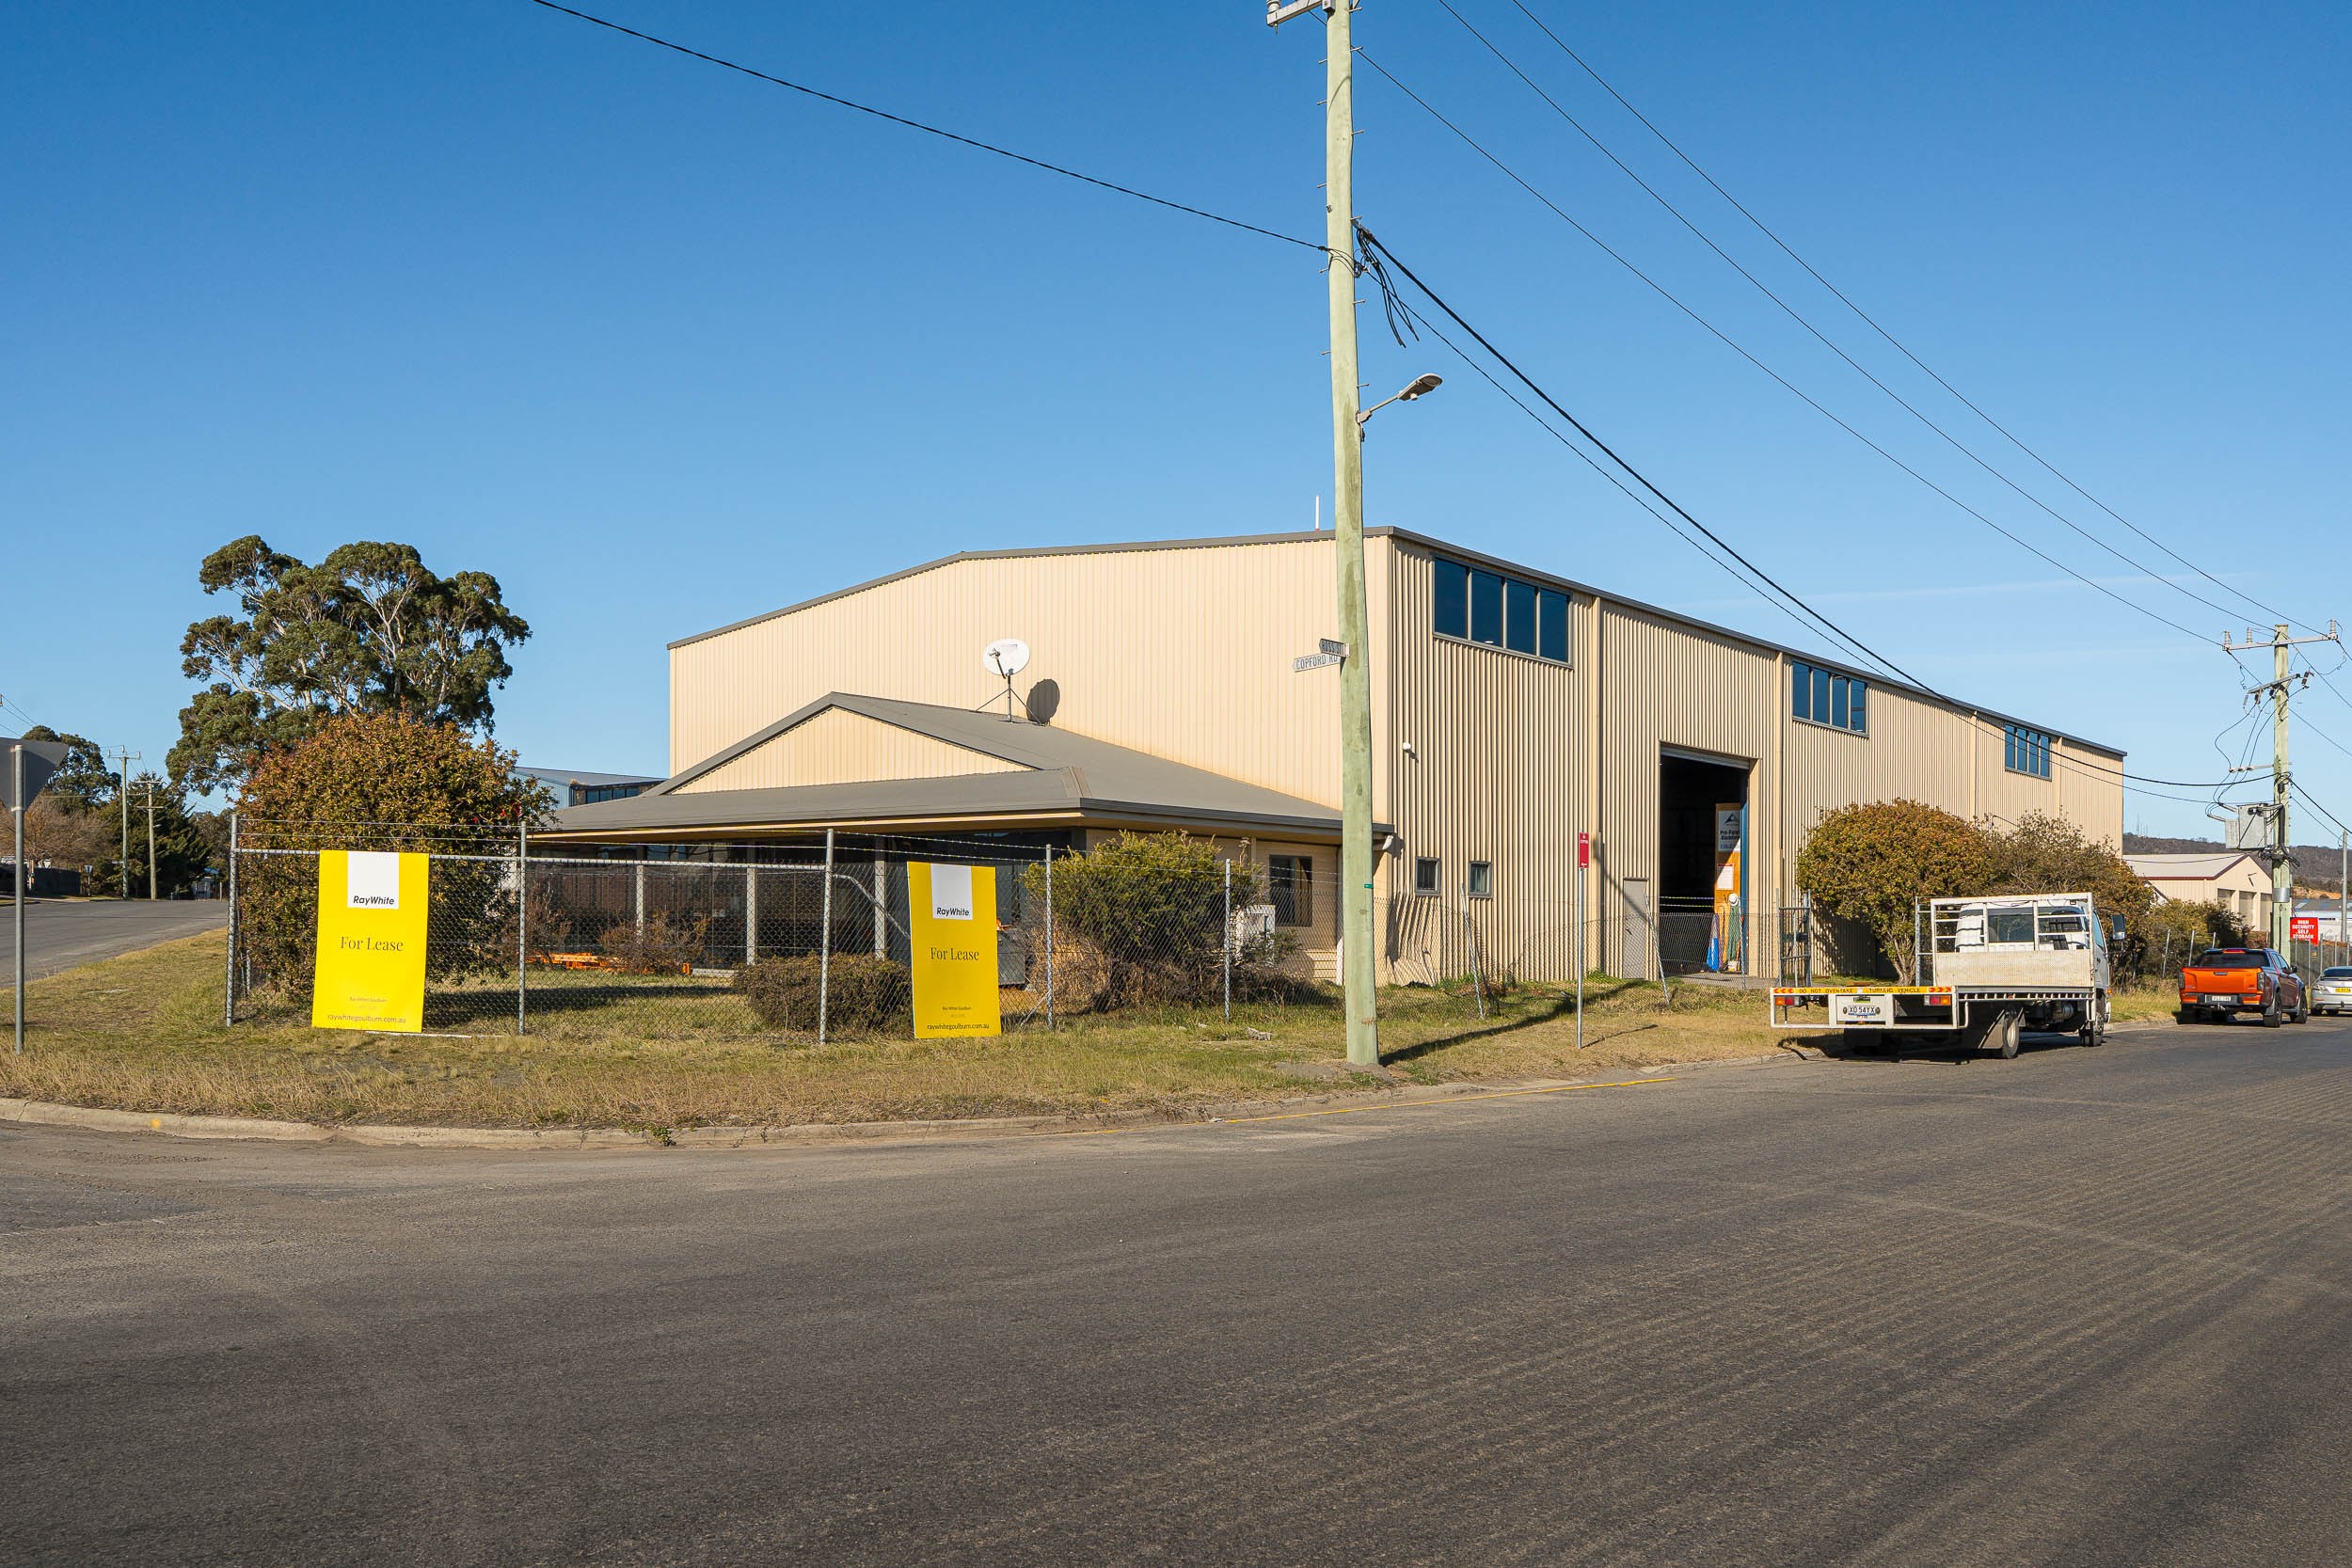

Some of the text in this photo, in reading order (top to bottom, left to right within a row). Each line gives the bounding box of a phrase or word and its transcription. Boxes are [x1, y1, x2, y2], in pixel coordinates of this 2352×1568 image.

[1295, 655, 1327, 670] COPFORD
[353, 895, 395, 905] RayWhite
[936, 907, 970, 916] RayWhite
[340, 936, 404, 952] For Lease
[930, 947, 979, 961] For Lease
[927, 1022, 990, 1031] raywhitegoulburn.com.au
